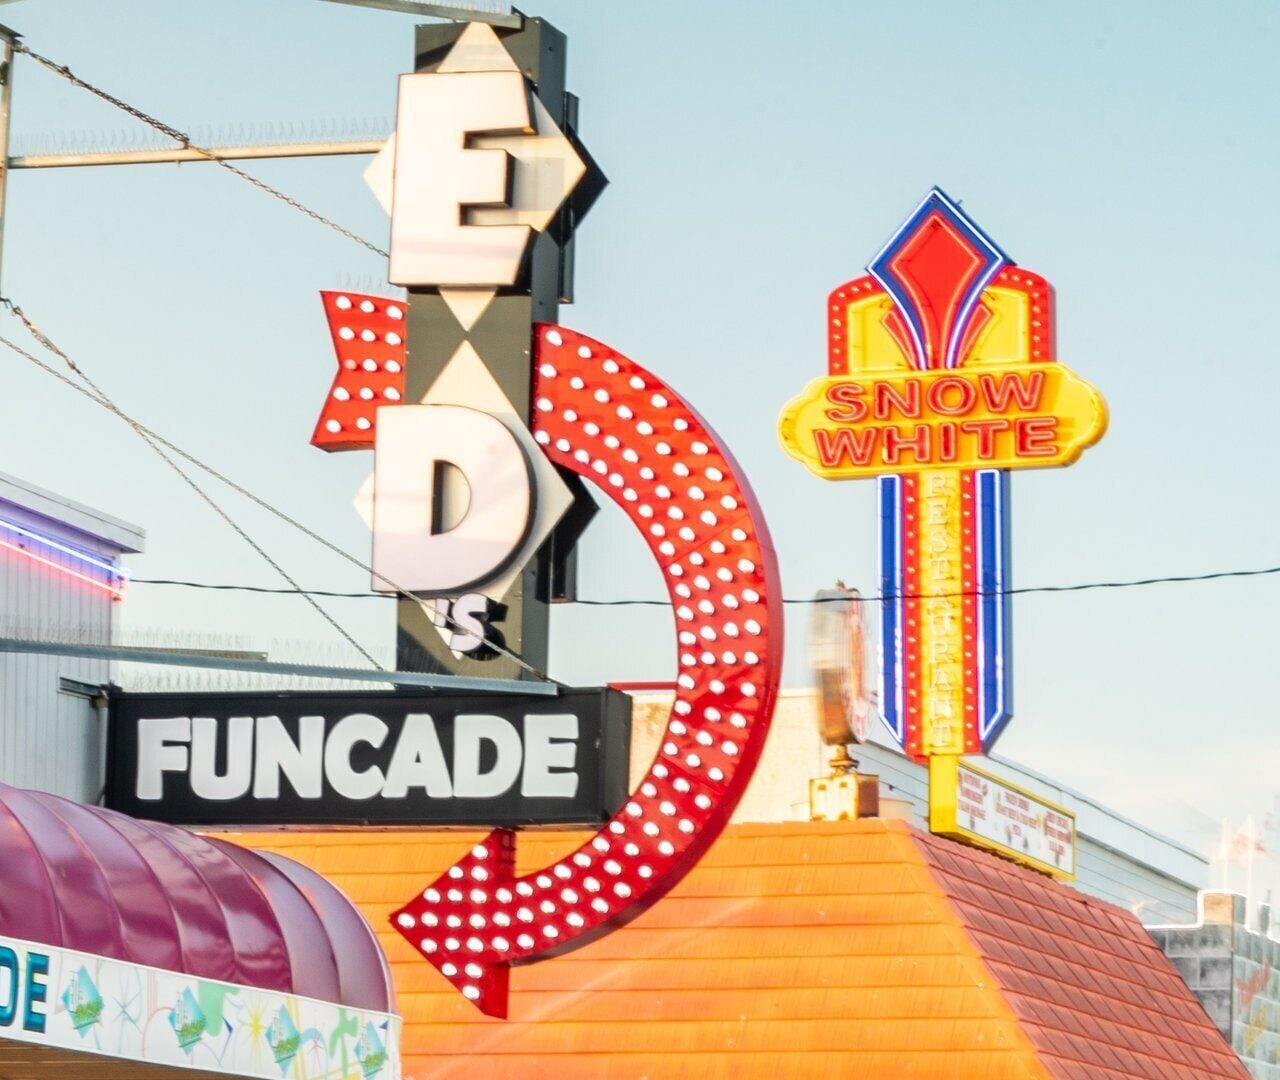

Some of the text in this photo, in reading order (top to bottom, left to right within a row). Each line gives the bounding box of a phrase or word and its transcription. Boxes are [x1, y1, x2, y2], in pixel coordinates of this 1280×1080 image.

[825, 370, 1045, 422] SNOW
[813, 416, 1058, 468] WHITE
[136, 713, 580, 800] FUNCADE
